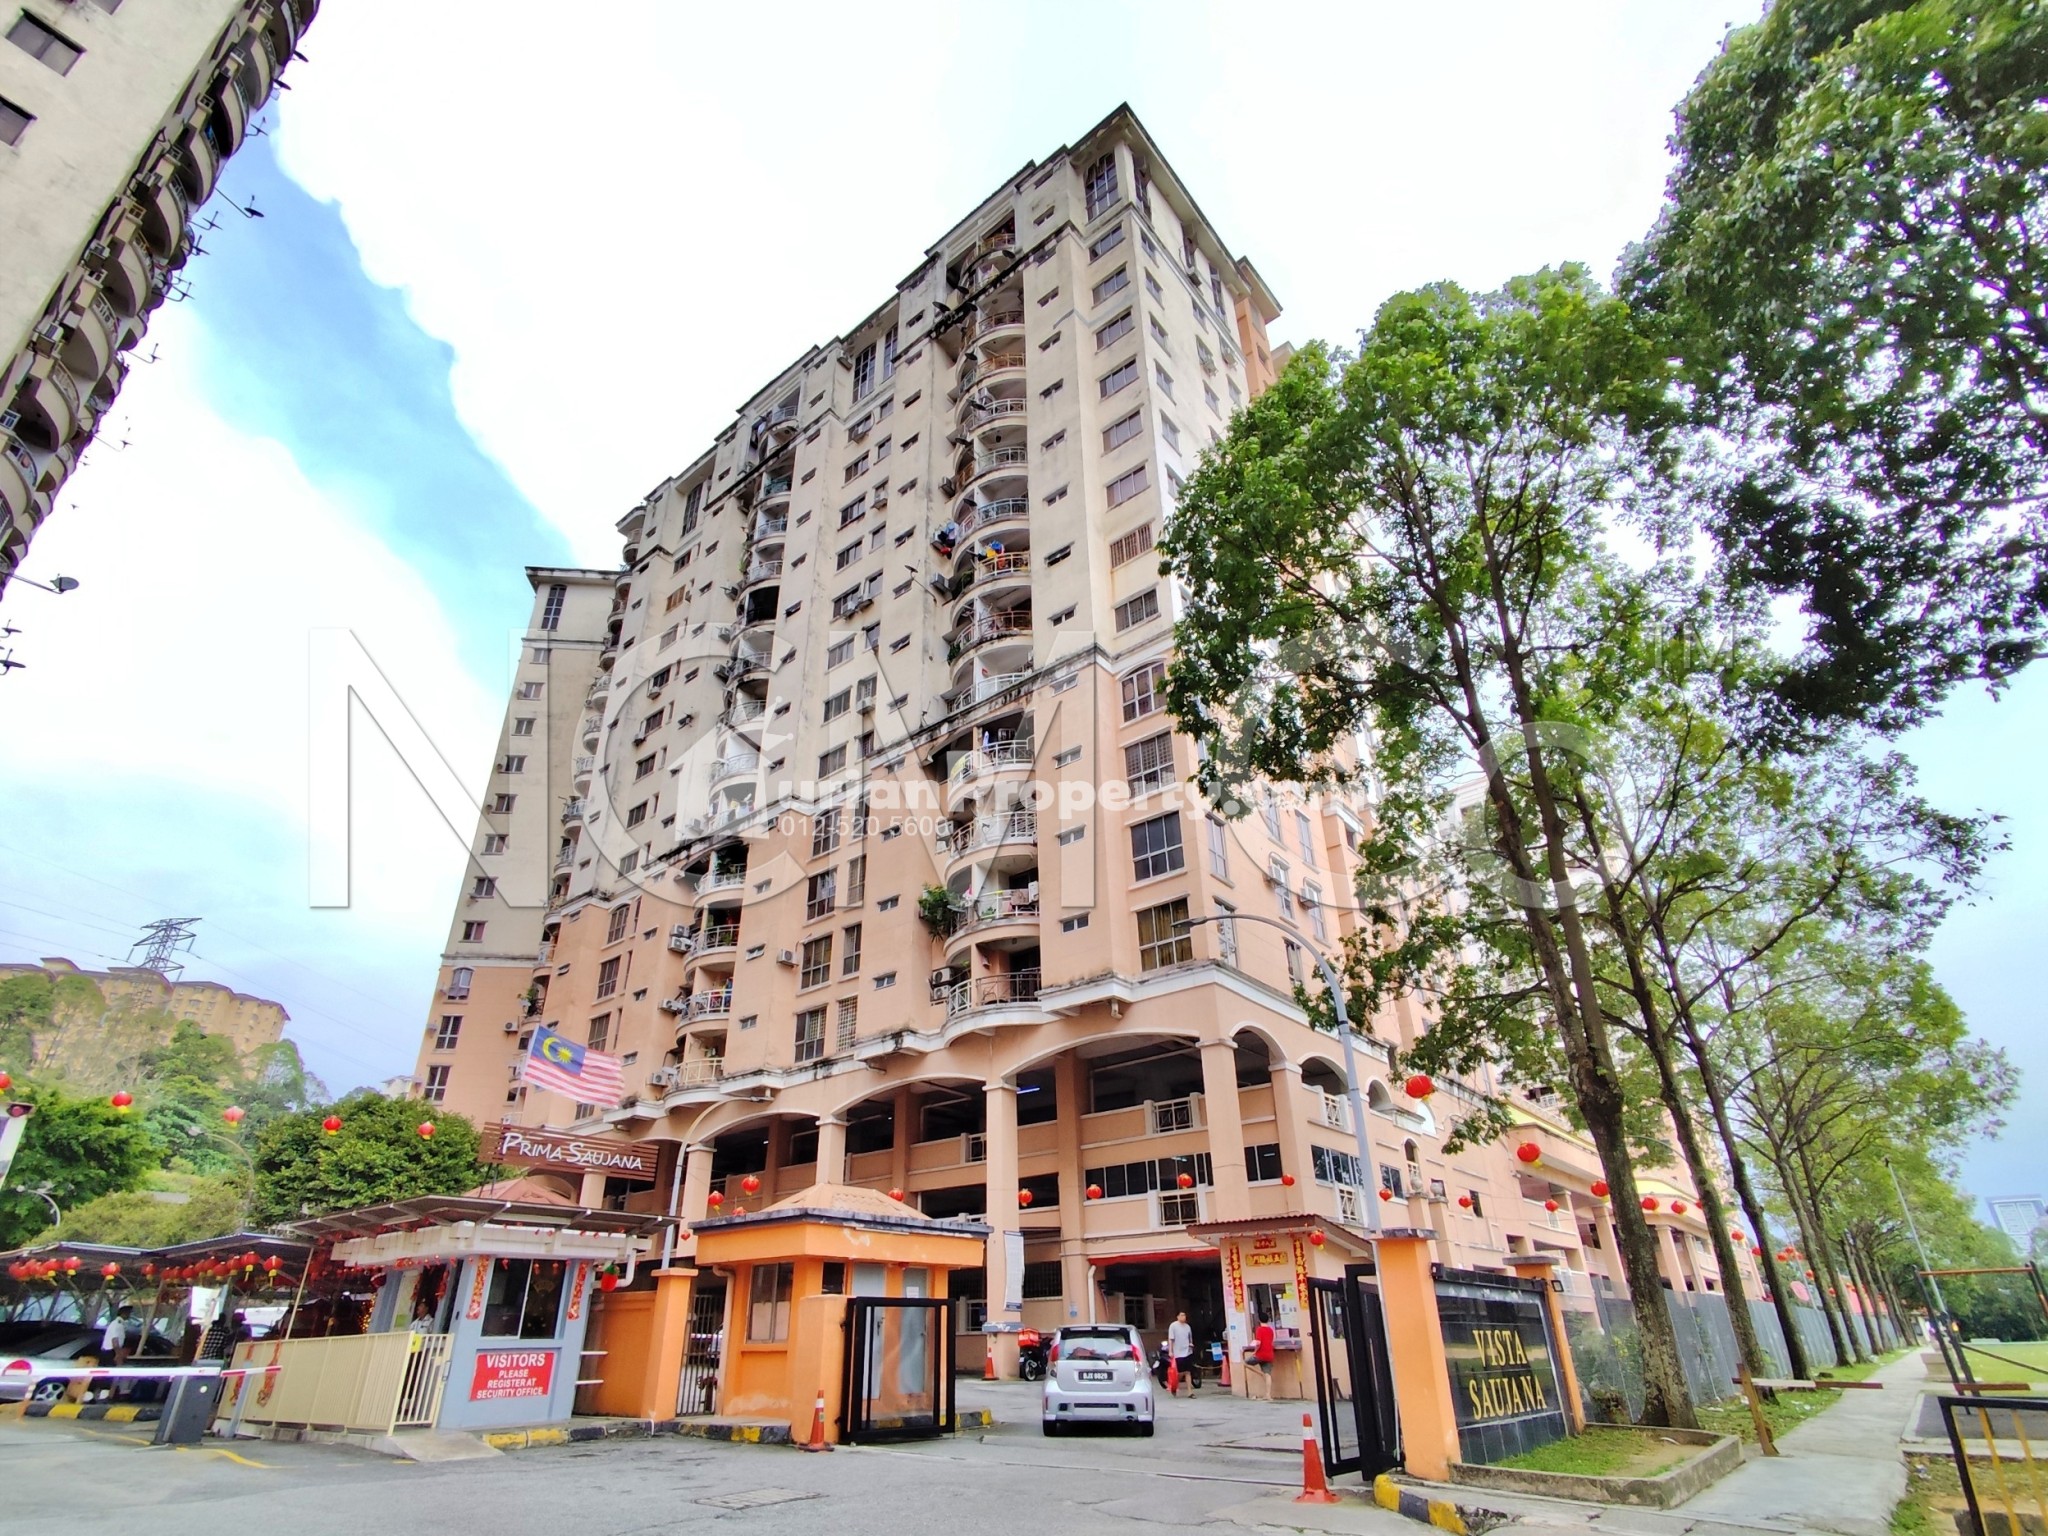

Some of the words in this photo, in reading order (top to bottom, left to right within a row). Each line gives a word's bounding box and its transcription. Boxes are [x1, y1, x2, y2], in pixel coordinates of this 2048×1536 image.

[502, 1132, 562, 1160] PRIMA
[566, 1142, 643, 1171] SAUJANA
[1472, 1329, 1528, 1367] VISTA
[487, 1353, 546, 1368] VISITORS
[499, 1369, 529, 1379] PLEASE
[487, 1378, 526, 1388] REGISTER
[526, 1377, 537, 1387] AT
[476, 1388, 516, 1399] SECURITY
[516, 1386, 544, 1397] OFFICE
[1469, 1374, 1548, 1420] SAUJANA
